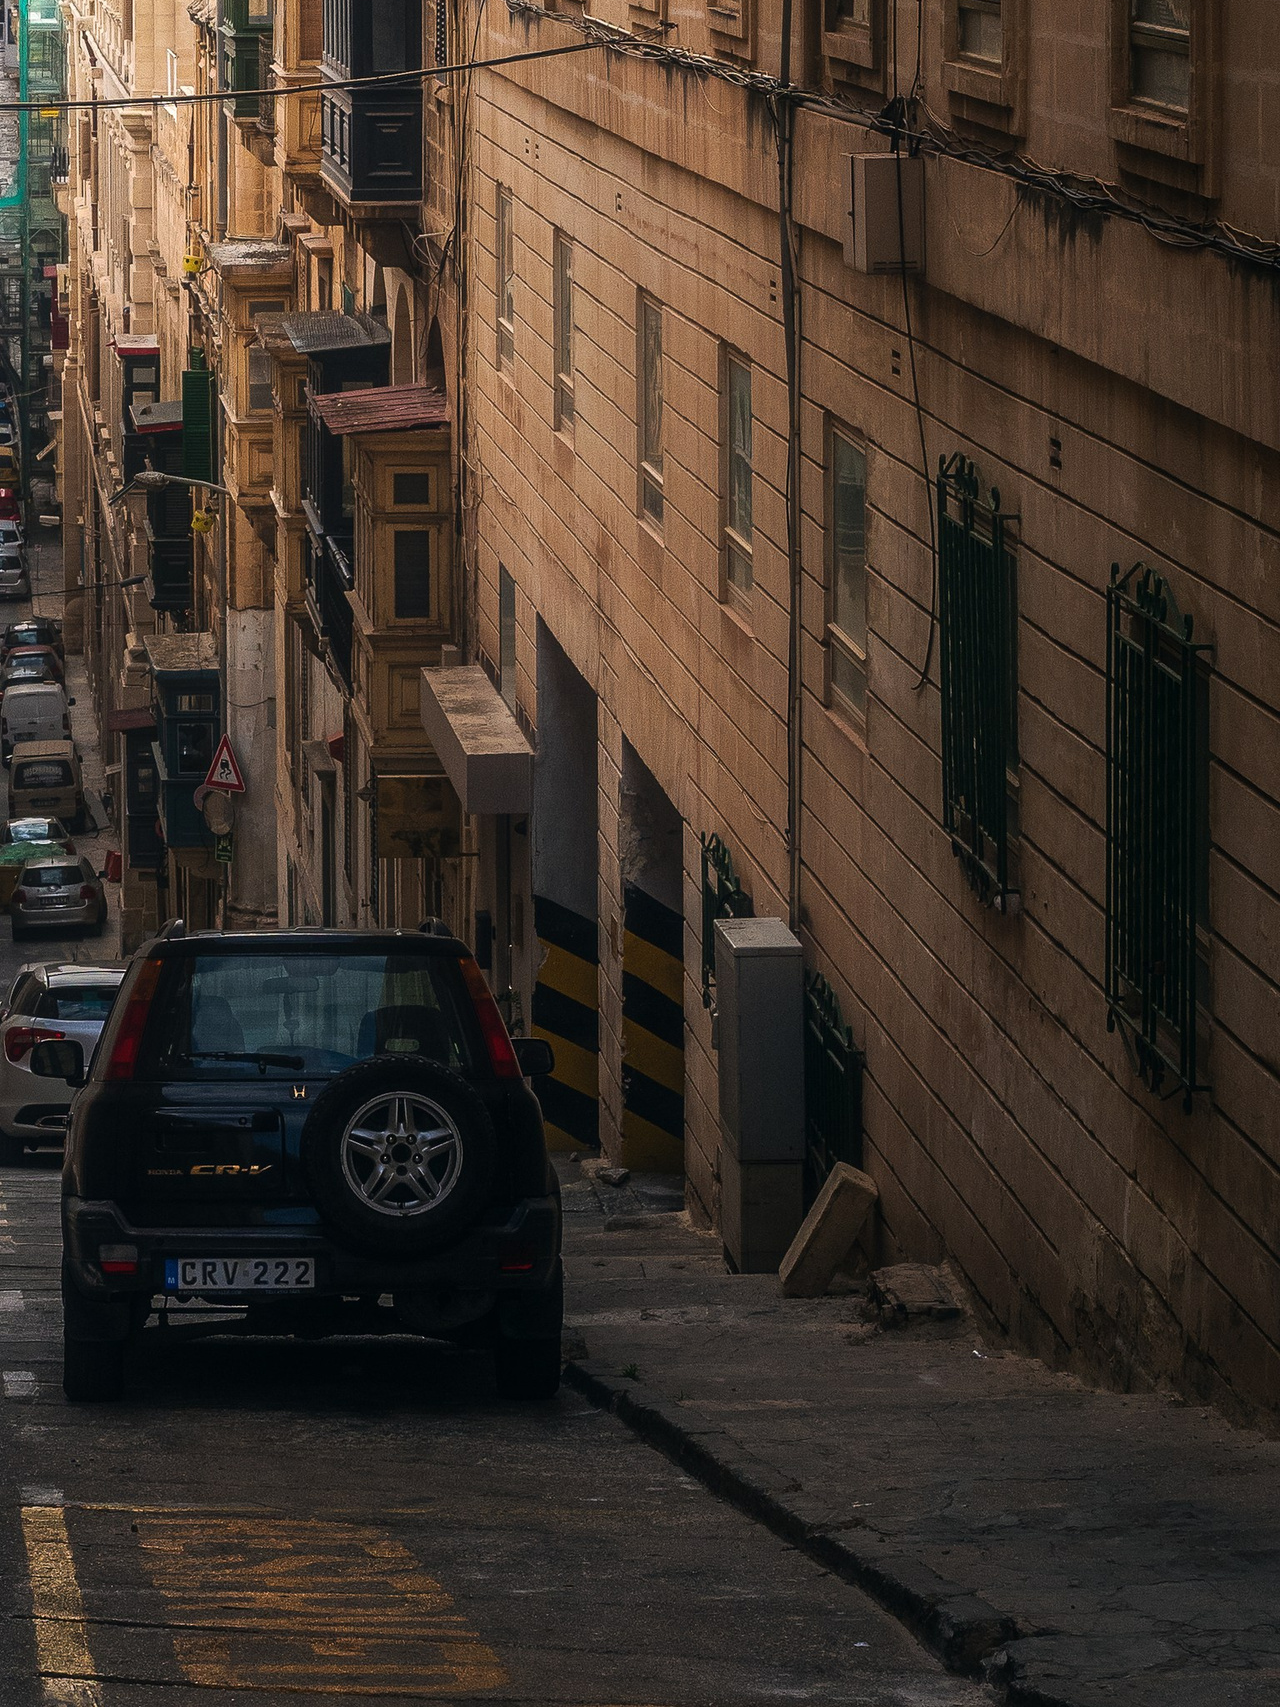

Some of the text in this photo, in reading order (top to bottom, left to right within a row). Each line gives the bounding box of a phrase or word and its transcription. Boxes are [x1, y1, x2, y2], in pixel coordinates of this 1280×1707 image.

[190, 1165, 273, 1175] CR-V
[168, 1276, 175, 1284] M
[181, 1261, 310, 1286] CRV 222
[136, 1517, 512, 1694] RESERVED
